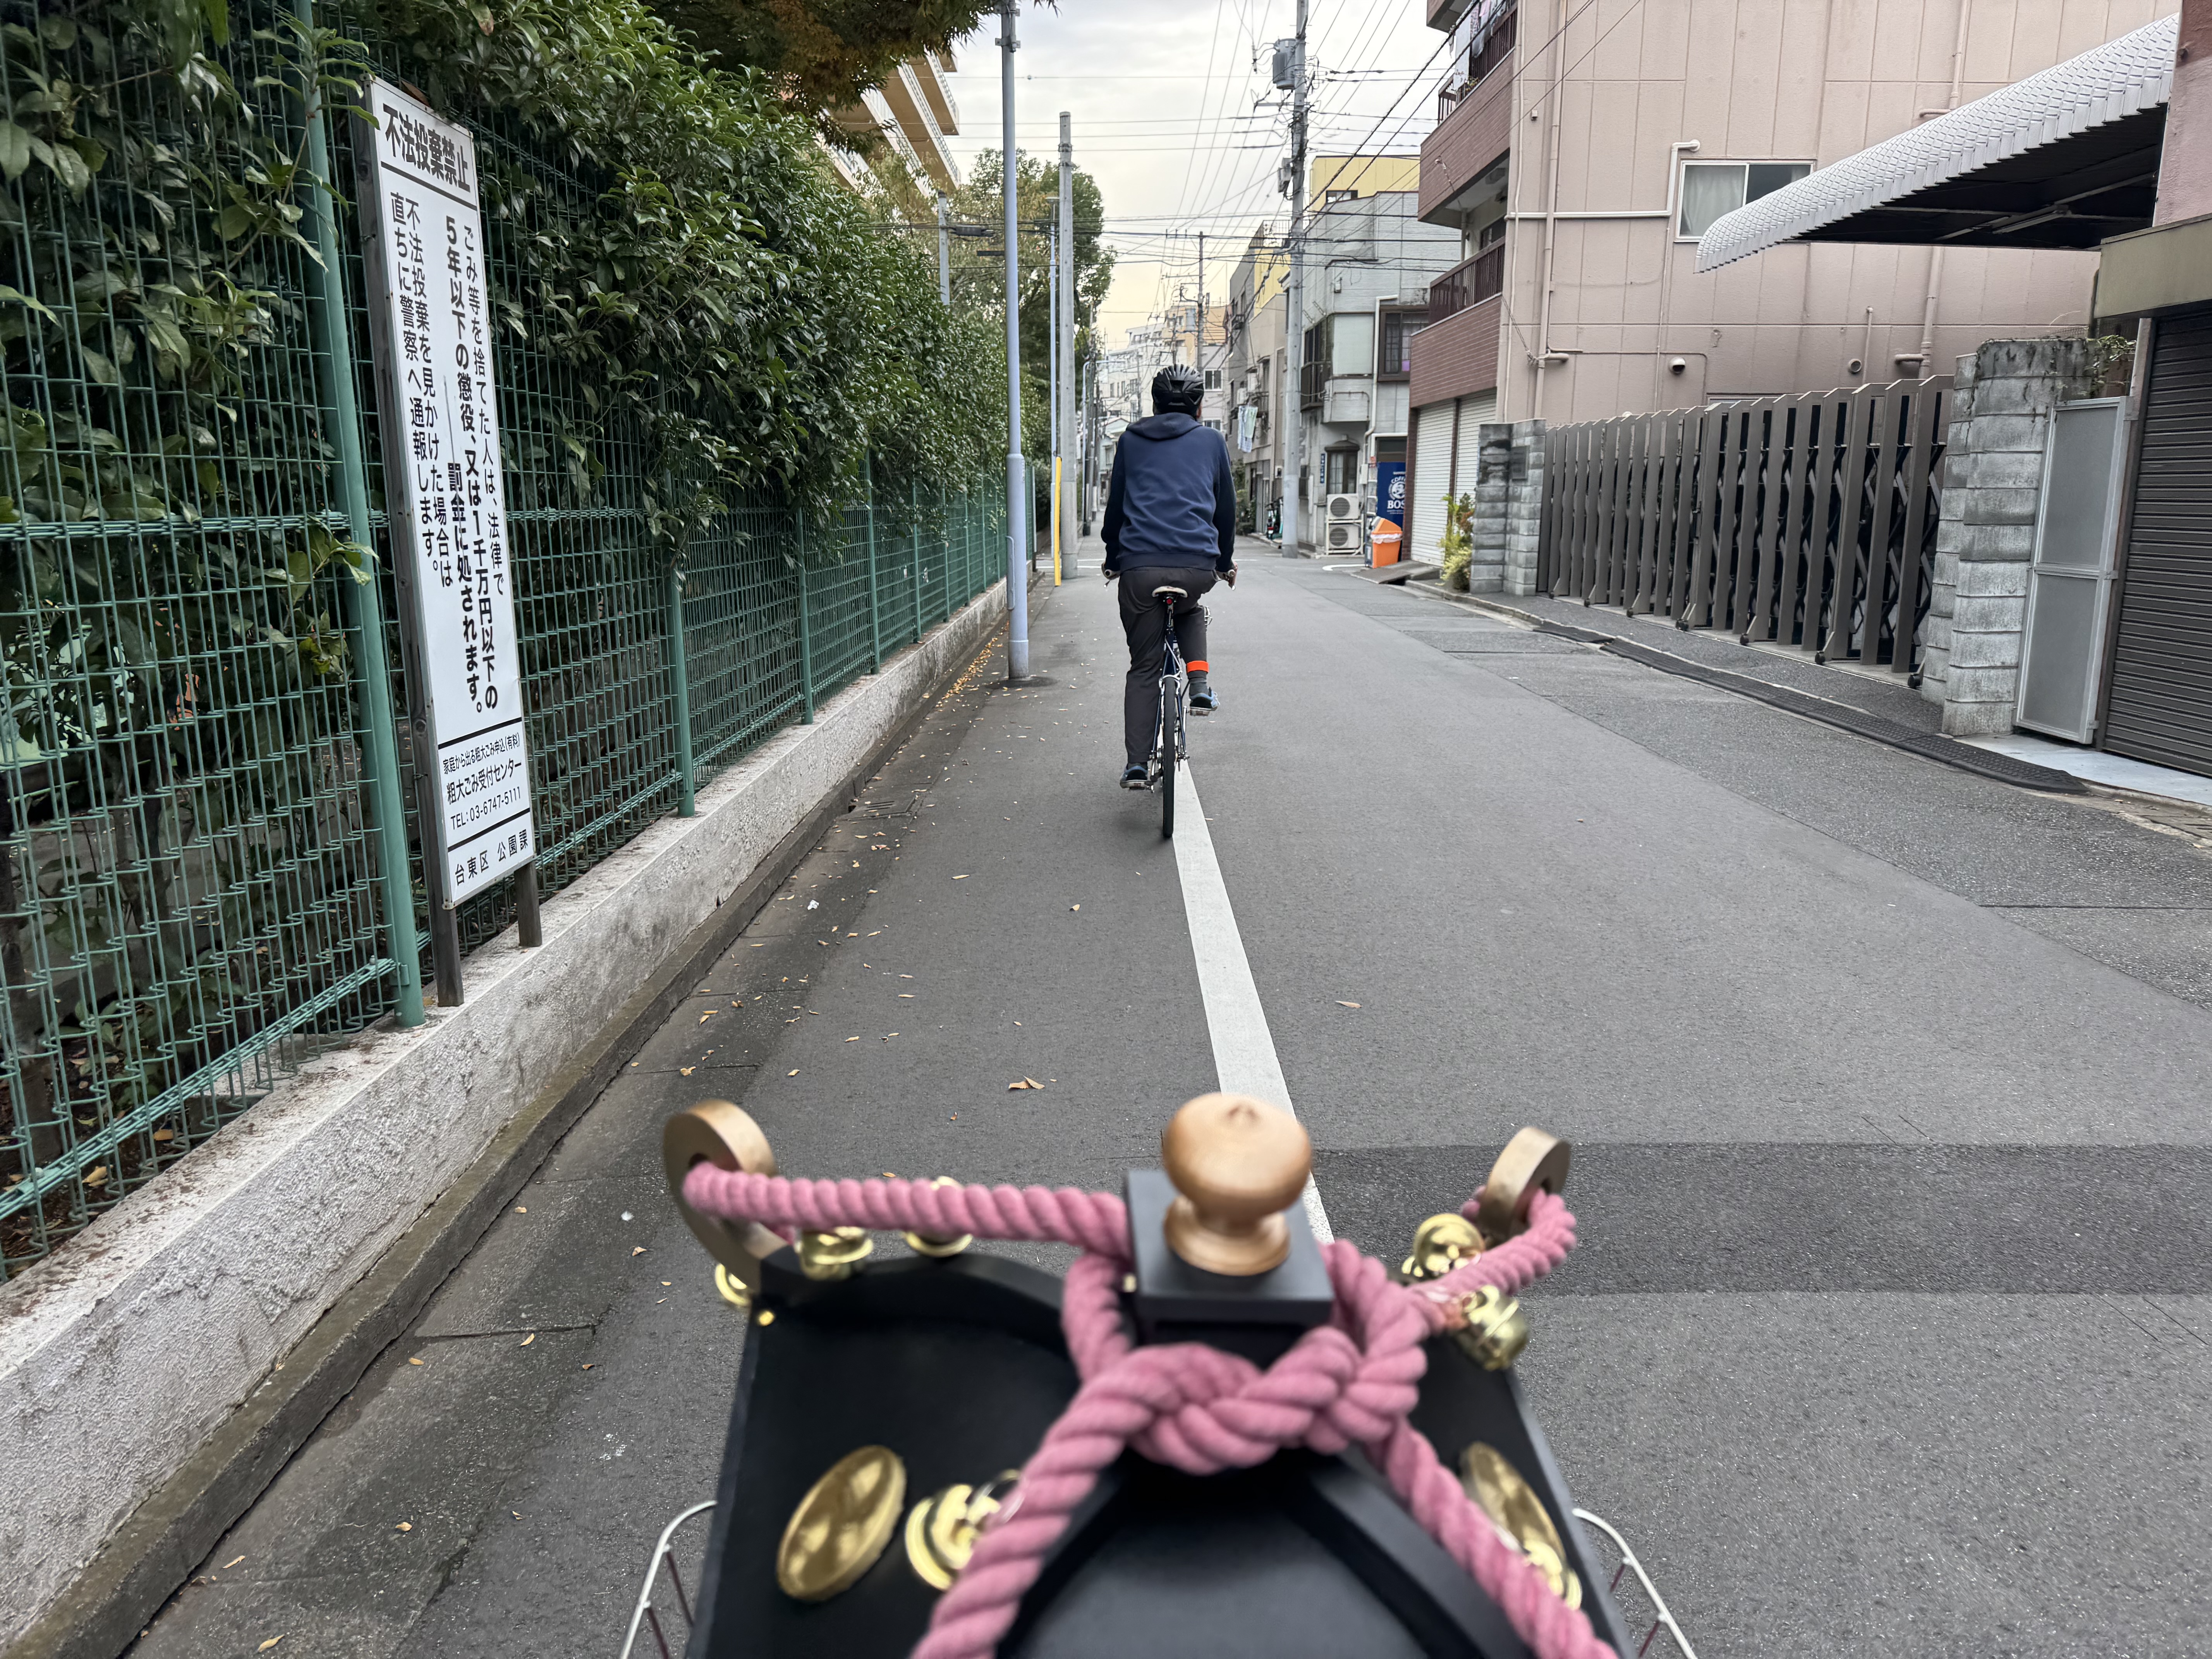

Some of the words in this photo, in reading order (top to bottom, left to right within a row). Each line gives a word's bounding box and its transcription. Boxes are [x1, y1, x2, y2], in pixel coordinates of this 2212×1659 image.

[383, 103, 470, 192] 不法投棄禁止
[391, 192, 438, 571] 直ちに警察へ通報します。
[406, 199, 453, 587] 不法投棄を見かけた場合は
[446, 216, 498, 709] 5年以下の懲役、又は1千万円以下の
[464, 226, 503, 595] ごみ等を捨てた人は、法律で
[448, 463, 481, 713] 罰金に処されます。
[443, 733, 519, 775] 家庭から出る粗大ごみ申込(有料)
[447, 758, 522, 804] 粗大ごみ受付センター
[455, 850, 488, 886] 台東区
[498, 829, 528, 862] 公園課
